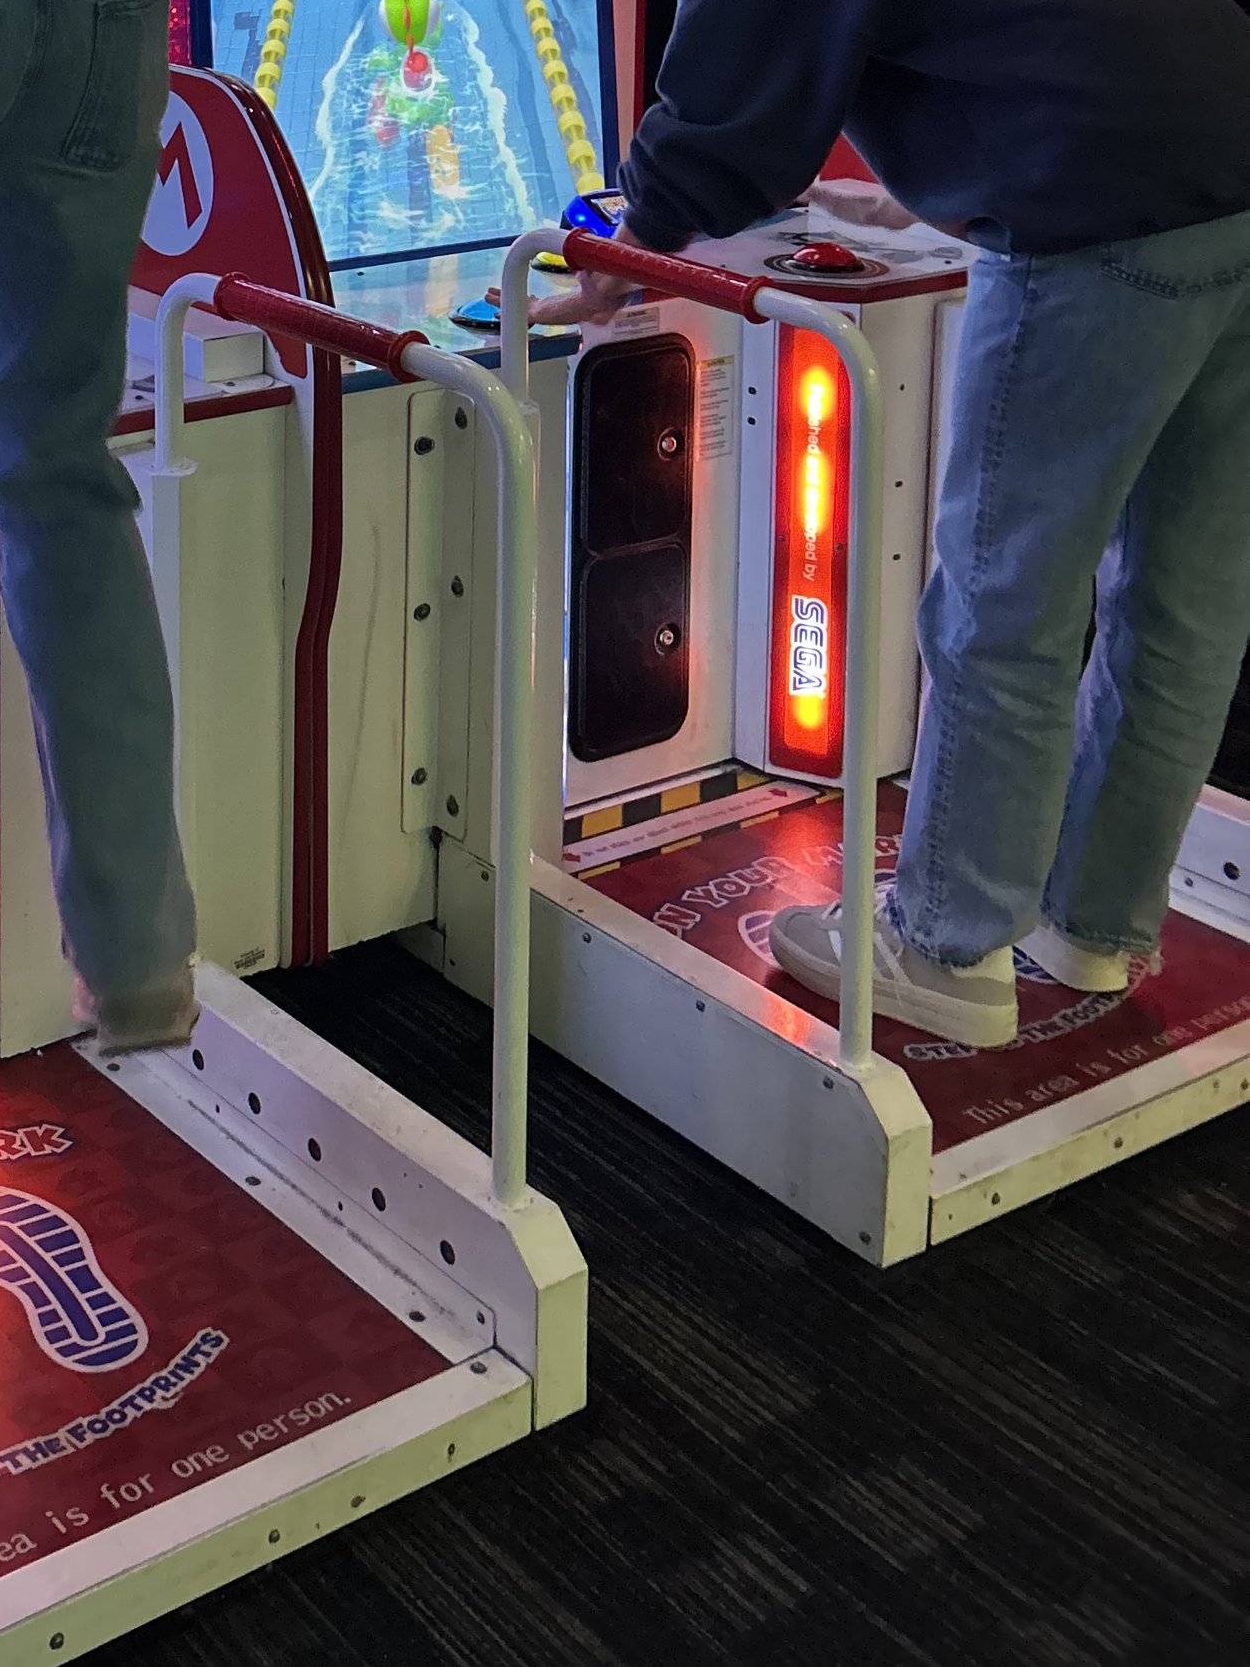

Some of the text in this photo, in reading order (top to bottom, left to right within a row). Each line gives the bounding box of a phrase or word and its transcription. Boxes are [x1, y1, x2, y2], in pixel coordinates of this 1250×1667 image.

[803, 563, 819, 582] by
[789, 595, 827, 697] SEGA
[963, 1098, 1024, 1126] This
[1025, 1072, 1079, 1103] area
[1076, 1060, 1111, 1077] is
[1107, 1043, 1150, 1066] for
[66, 1326, 230, 1450] FOOTPRINTS
[49, 1507, 90, 1535] is
[98, 1471, 155, 1511] for
[170, 1441, 230, 1480] one
[238, 1392, 353, 1452] person.
